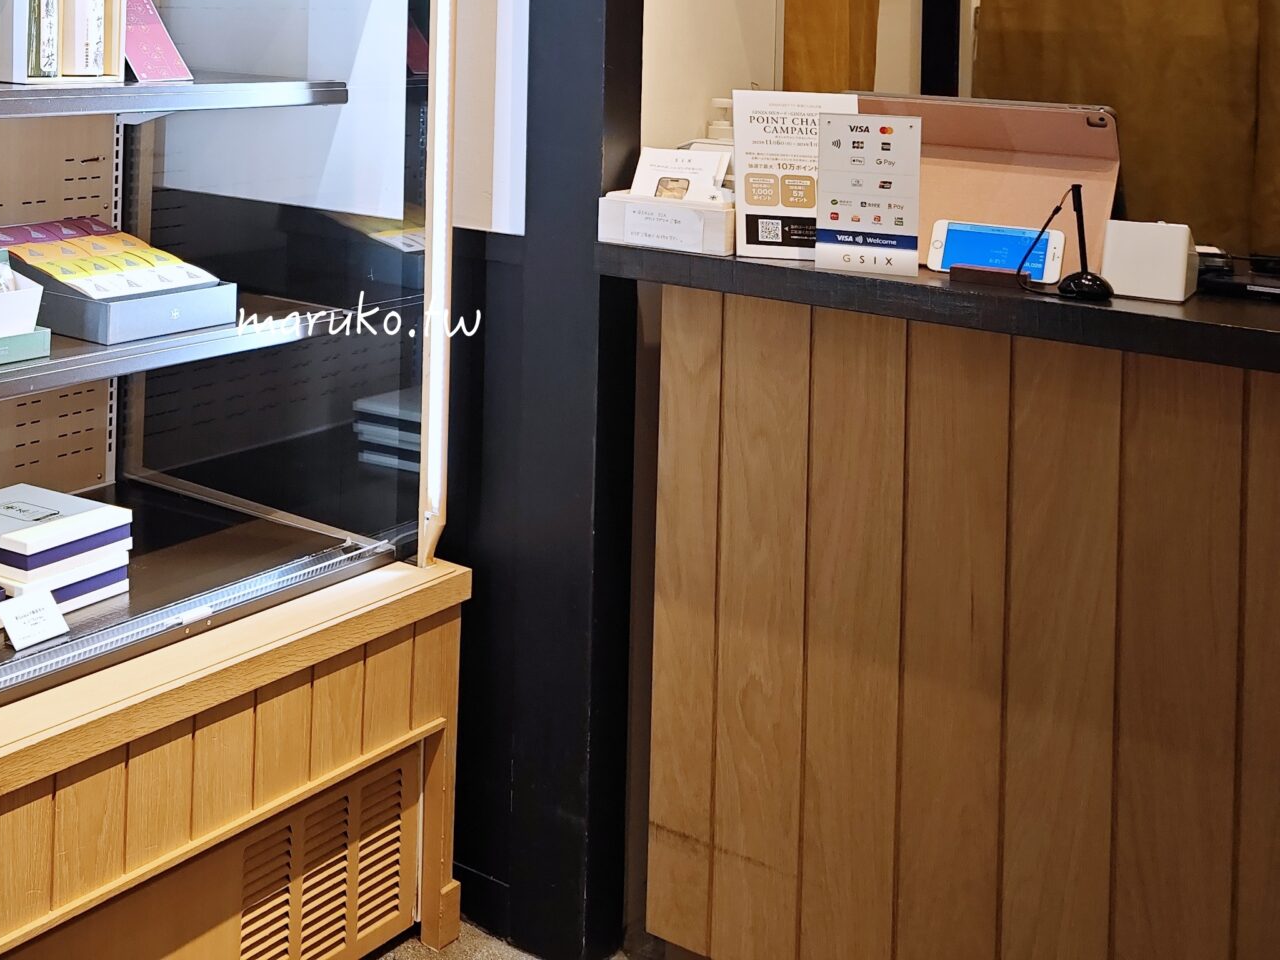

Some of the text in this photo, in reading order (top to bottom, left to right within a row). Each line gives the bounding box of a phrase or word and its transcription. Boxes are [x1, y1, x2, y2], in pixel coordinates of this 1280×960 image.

[749, 115, 787, 125] POINT
[763, 126, 817, 136] CAMPAIG
[849, 125, 870, 133] VISA
[867, 237, 897, 245] Welcome
